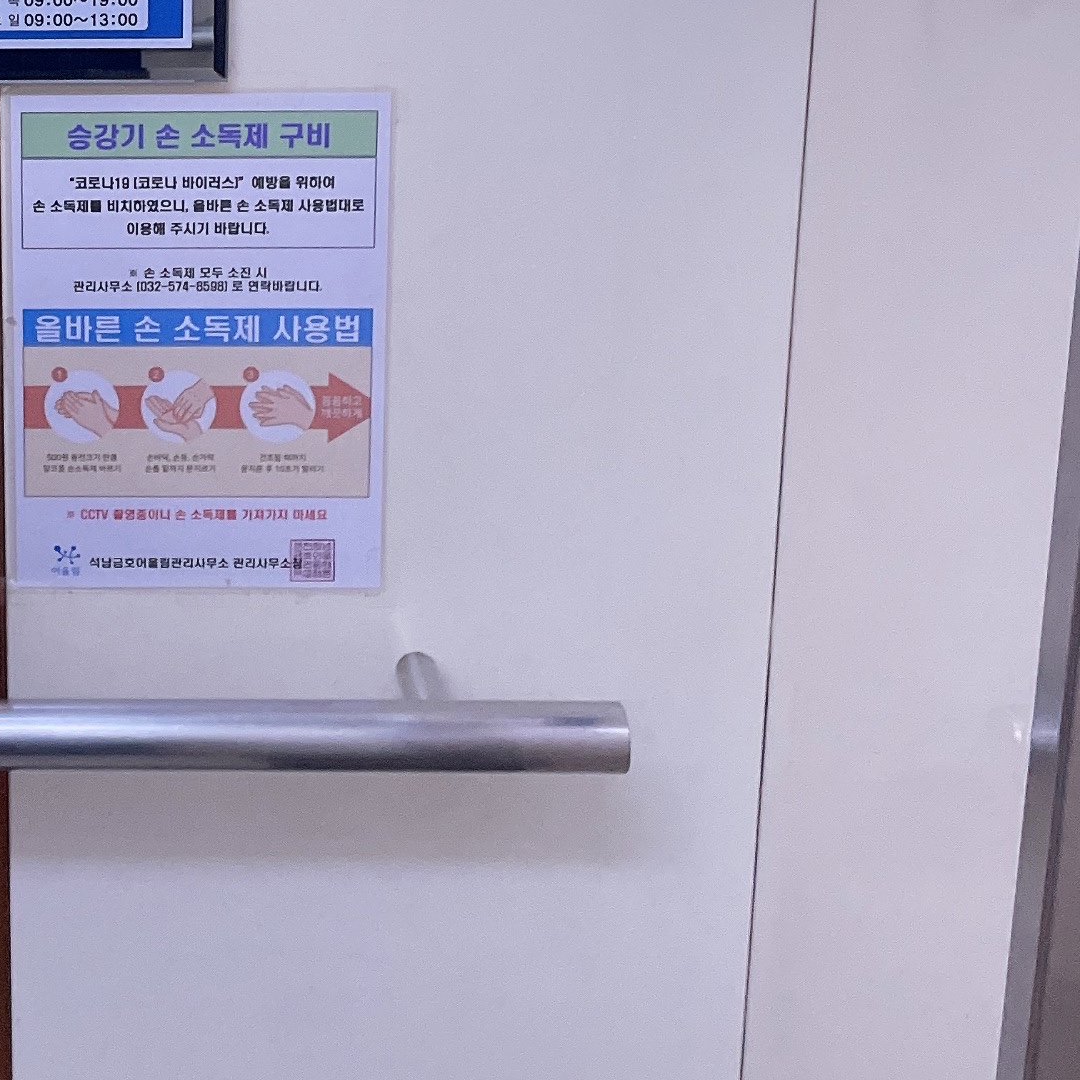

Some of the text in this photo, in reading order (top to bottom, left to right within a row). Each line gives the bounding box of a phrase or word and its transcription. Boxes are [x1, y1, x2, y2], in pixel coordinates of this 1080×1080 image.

[68, 123, 330, 150] 승강기 손 소독제 구비
[252, 176, 291, 189] 예방을
[296, 176, 335, 189] 위하여
[33, 200, 45, 213] 손
[50, 200, 102, 213] 소독제를
[193, 199, 232, 213] 올바른
[237, 199, 249, 212] 손
[254, 199, 294, 212] 소독제
[298, 198, 364, 212] 사용법대로
[126, 221, 270, 235] 이용해 주시기 바랍니다.
[144, 267, 267, 278] 손 소독제 모두 소진 시
[74, 281, 132, 292] 관리사무소
[232, 281, 243, 291] 로
[35, 315, 360, 343] 올바른 손 소독제 사용법
[81, 510, 108, 520] CCTV
[175, 510, 186, 520] 손
[192, 509, 237, 520] 소독제를
[242, 509, 288, 520] 가져가지
[293, 509, 327, 520] 마세요
